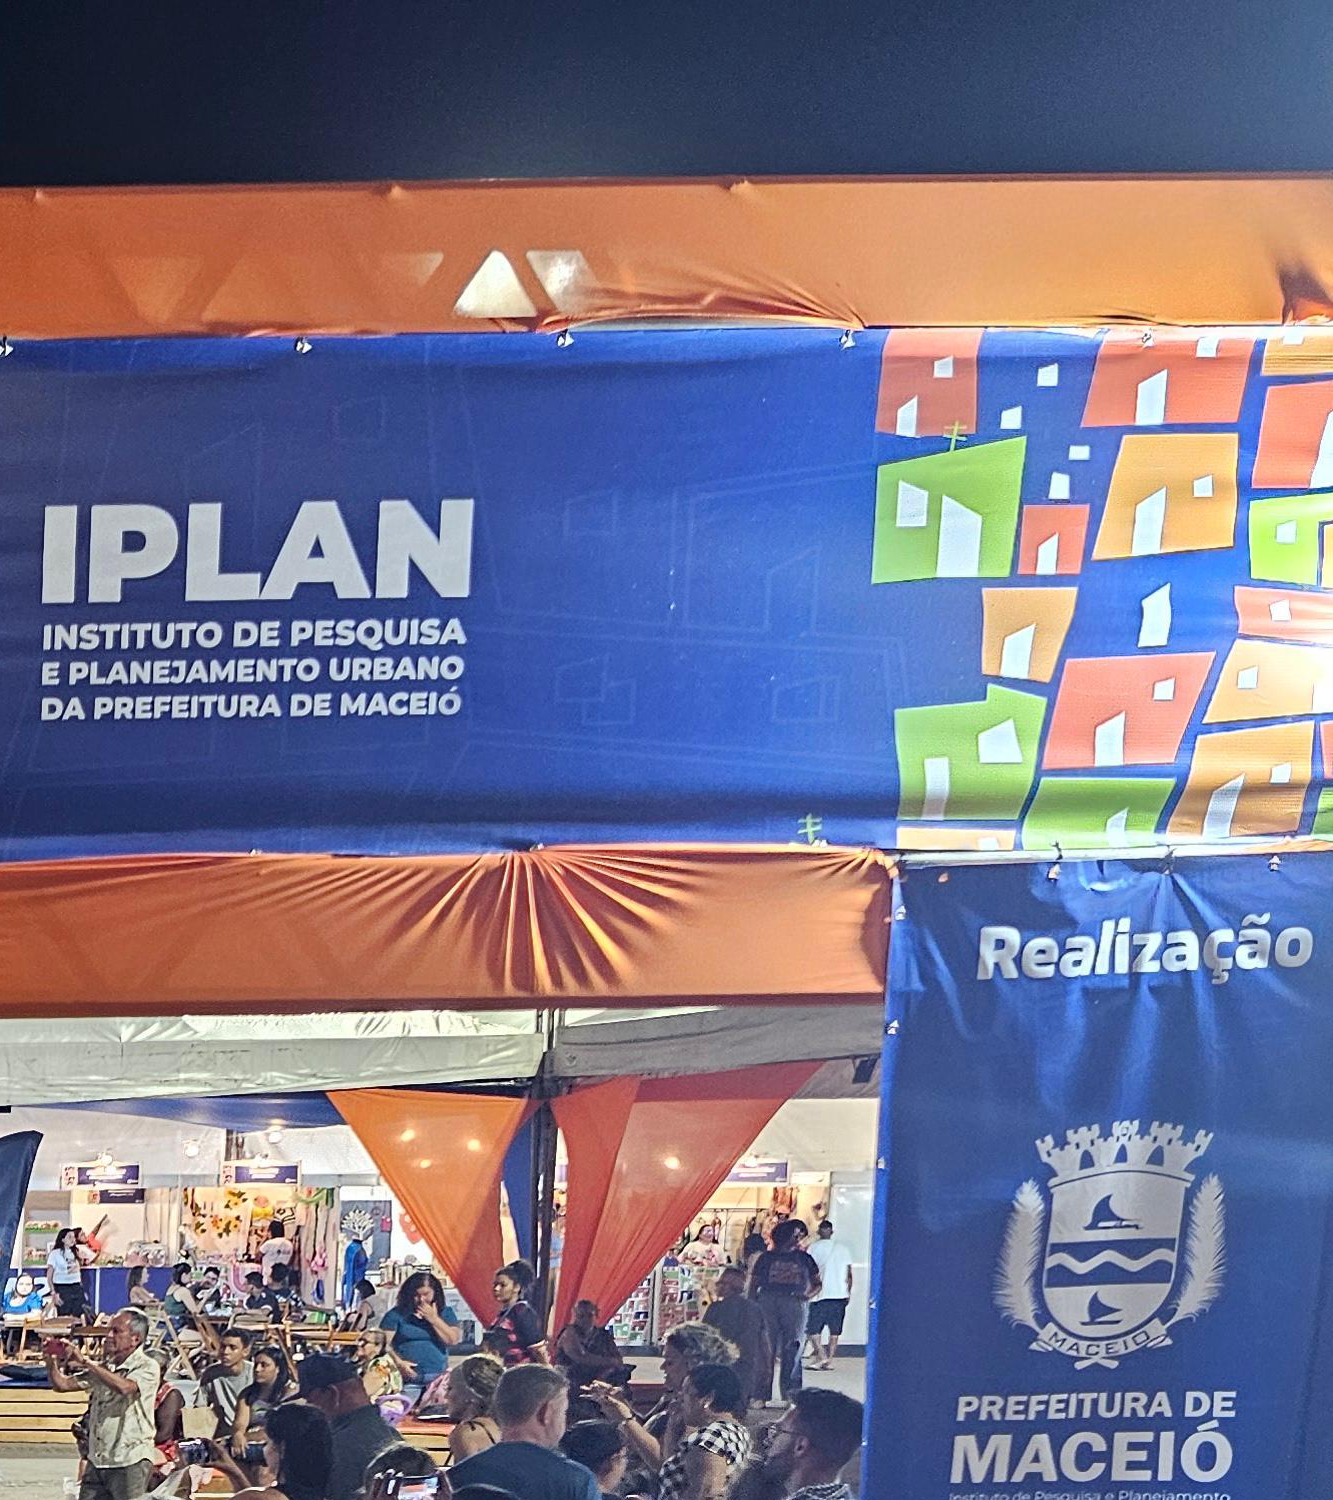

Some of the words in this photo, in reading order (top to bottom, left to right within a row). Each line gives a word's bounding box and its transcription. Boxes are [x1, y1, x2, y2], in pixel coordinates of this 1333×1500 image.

[41, 498, 474, 604] IPLAN
[42, 622, 223, 651] INSTITUTO
[233, 620, 280, 648] DE
[290, 618, 468, 651] PESQUISA
[41, 661, 60, 686] E
[68, 657, 321, 685] PLANEJAMENTO
[329, 655, 465, 682] URBANO
[41, 696, 85, 721] DA
[93, 692, 283, 720] PREFEITURA
[290, 692, 332, 717] DE
[339, 686, 462, 716] MACEIÓ
[976, 910, 1315, 985] Realização
[1047, 1329, 1152, 1358] MACEIO
[956, 1392, 1172, 1422] PREFEITURA
[1184, 1391, 1236, 1419] DE
[949, 1420, 1233, 1484] MACEIÓ
